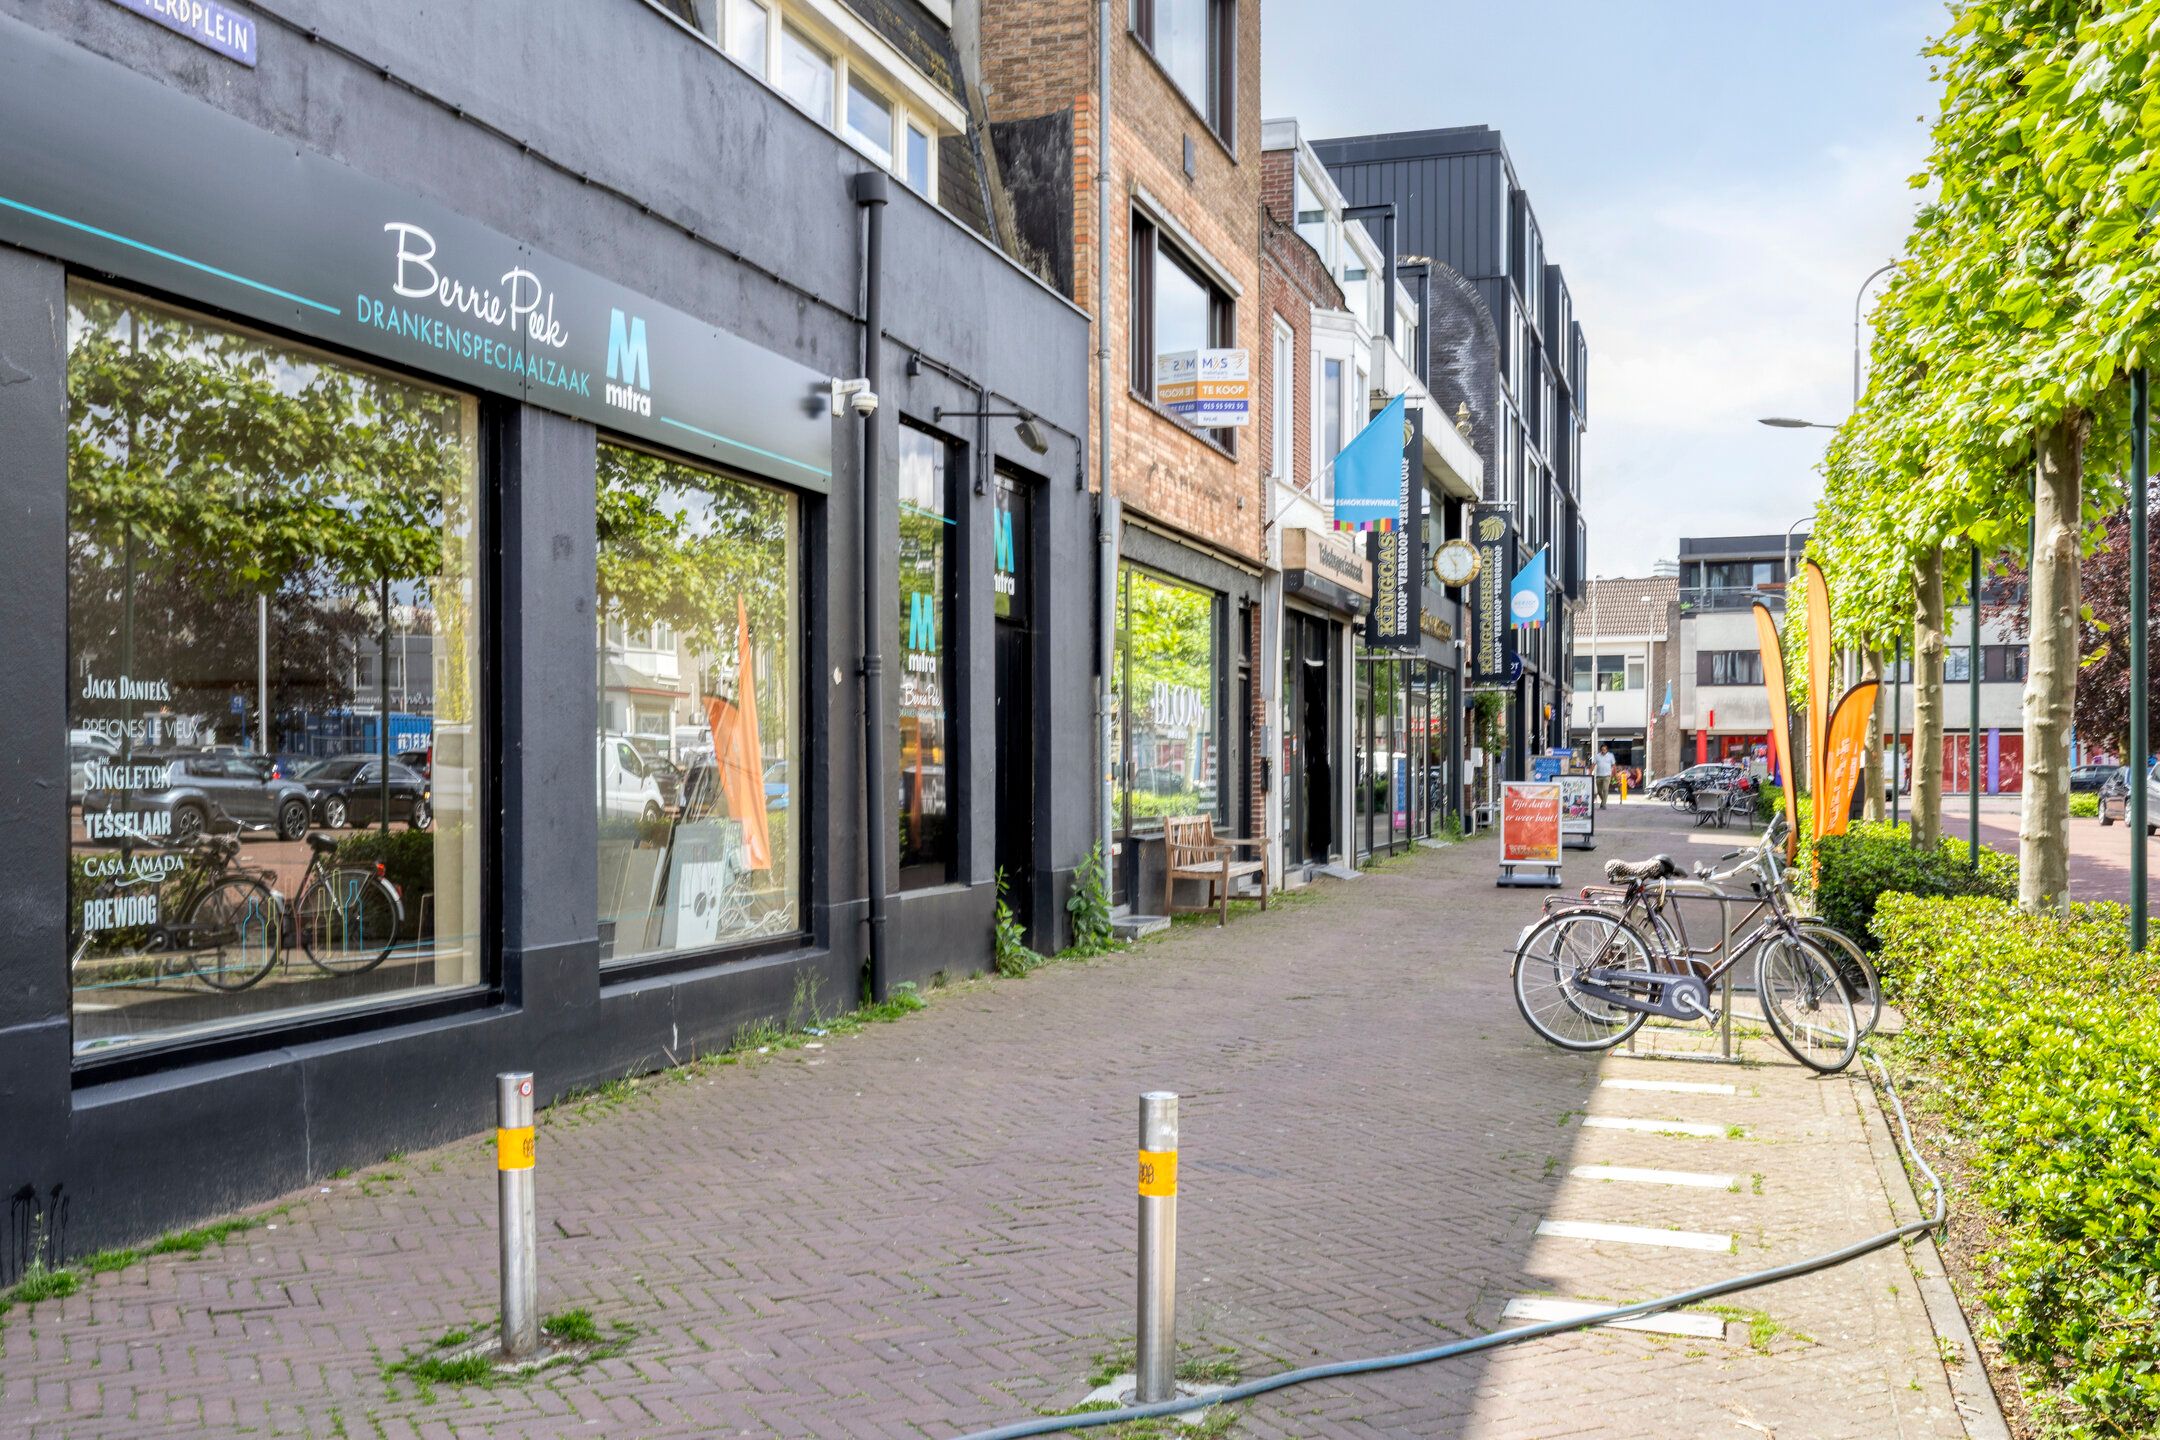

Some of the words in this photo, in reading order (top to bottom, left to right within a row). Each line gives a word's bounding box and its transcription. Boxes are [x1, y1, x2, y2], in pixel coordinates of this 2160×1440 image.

[145, 0, 247, 53] RDPLEIN
[384, 222, 505, 327] Berrie
[501, 265, 568, 348] Peek
[357, 294, 590, 397] DRANKENSPECIAALZAAK
[606, 384, 651, 417] mitra
[1202, 385, 1214, 395] TE
[1216, 385, 1245, 395] KOOP
[1374, 532, 1397, 637] KINGCAS
[908, 652, 936, 673] mitra
[82, 674, 116, 699] JACK
[1154, 682, 1201, 727] BLOOM
[148, 719, 162, 738] LE
[164, 718, 199, 739] VIEUX
[98, 755, 110, 765] THE
[83, 761, 172, 791] SINGLETON
[84, 811, 172, 839] TESSELAAR
[84, 857, 126, 878] CASA
[124, 854, 185, 881] AMADA
[84, 894, 157, 932] BREWDOG
